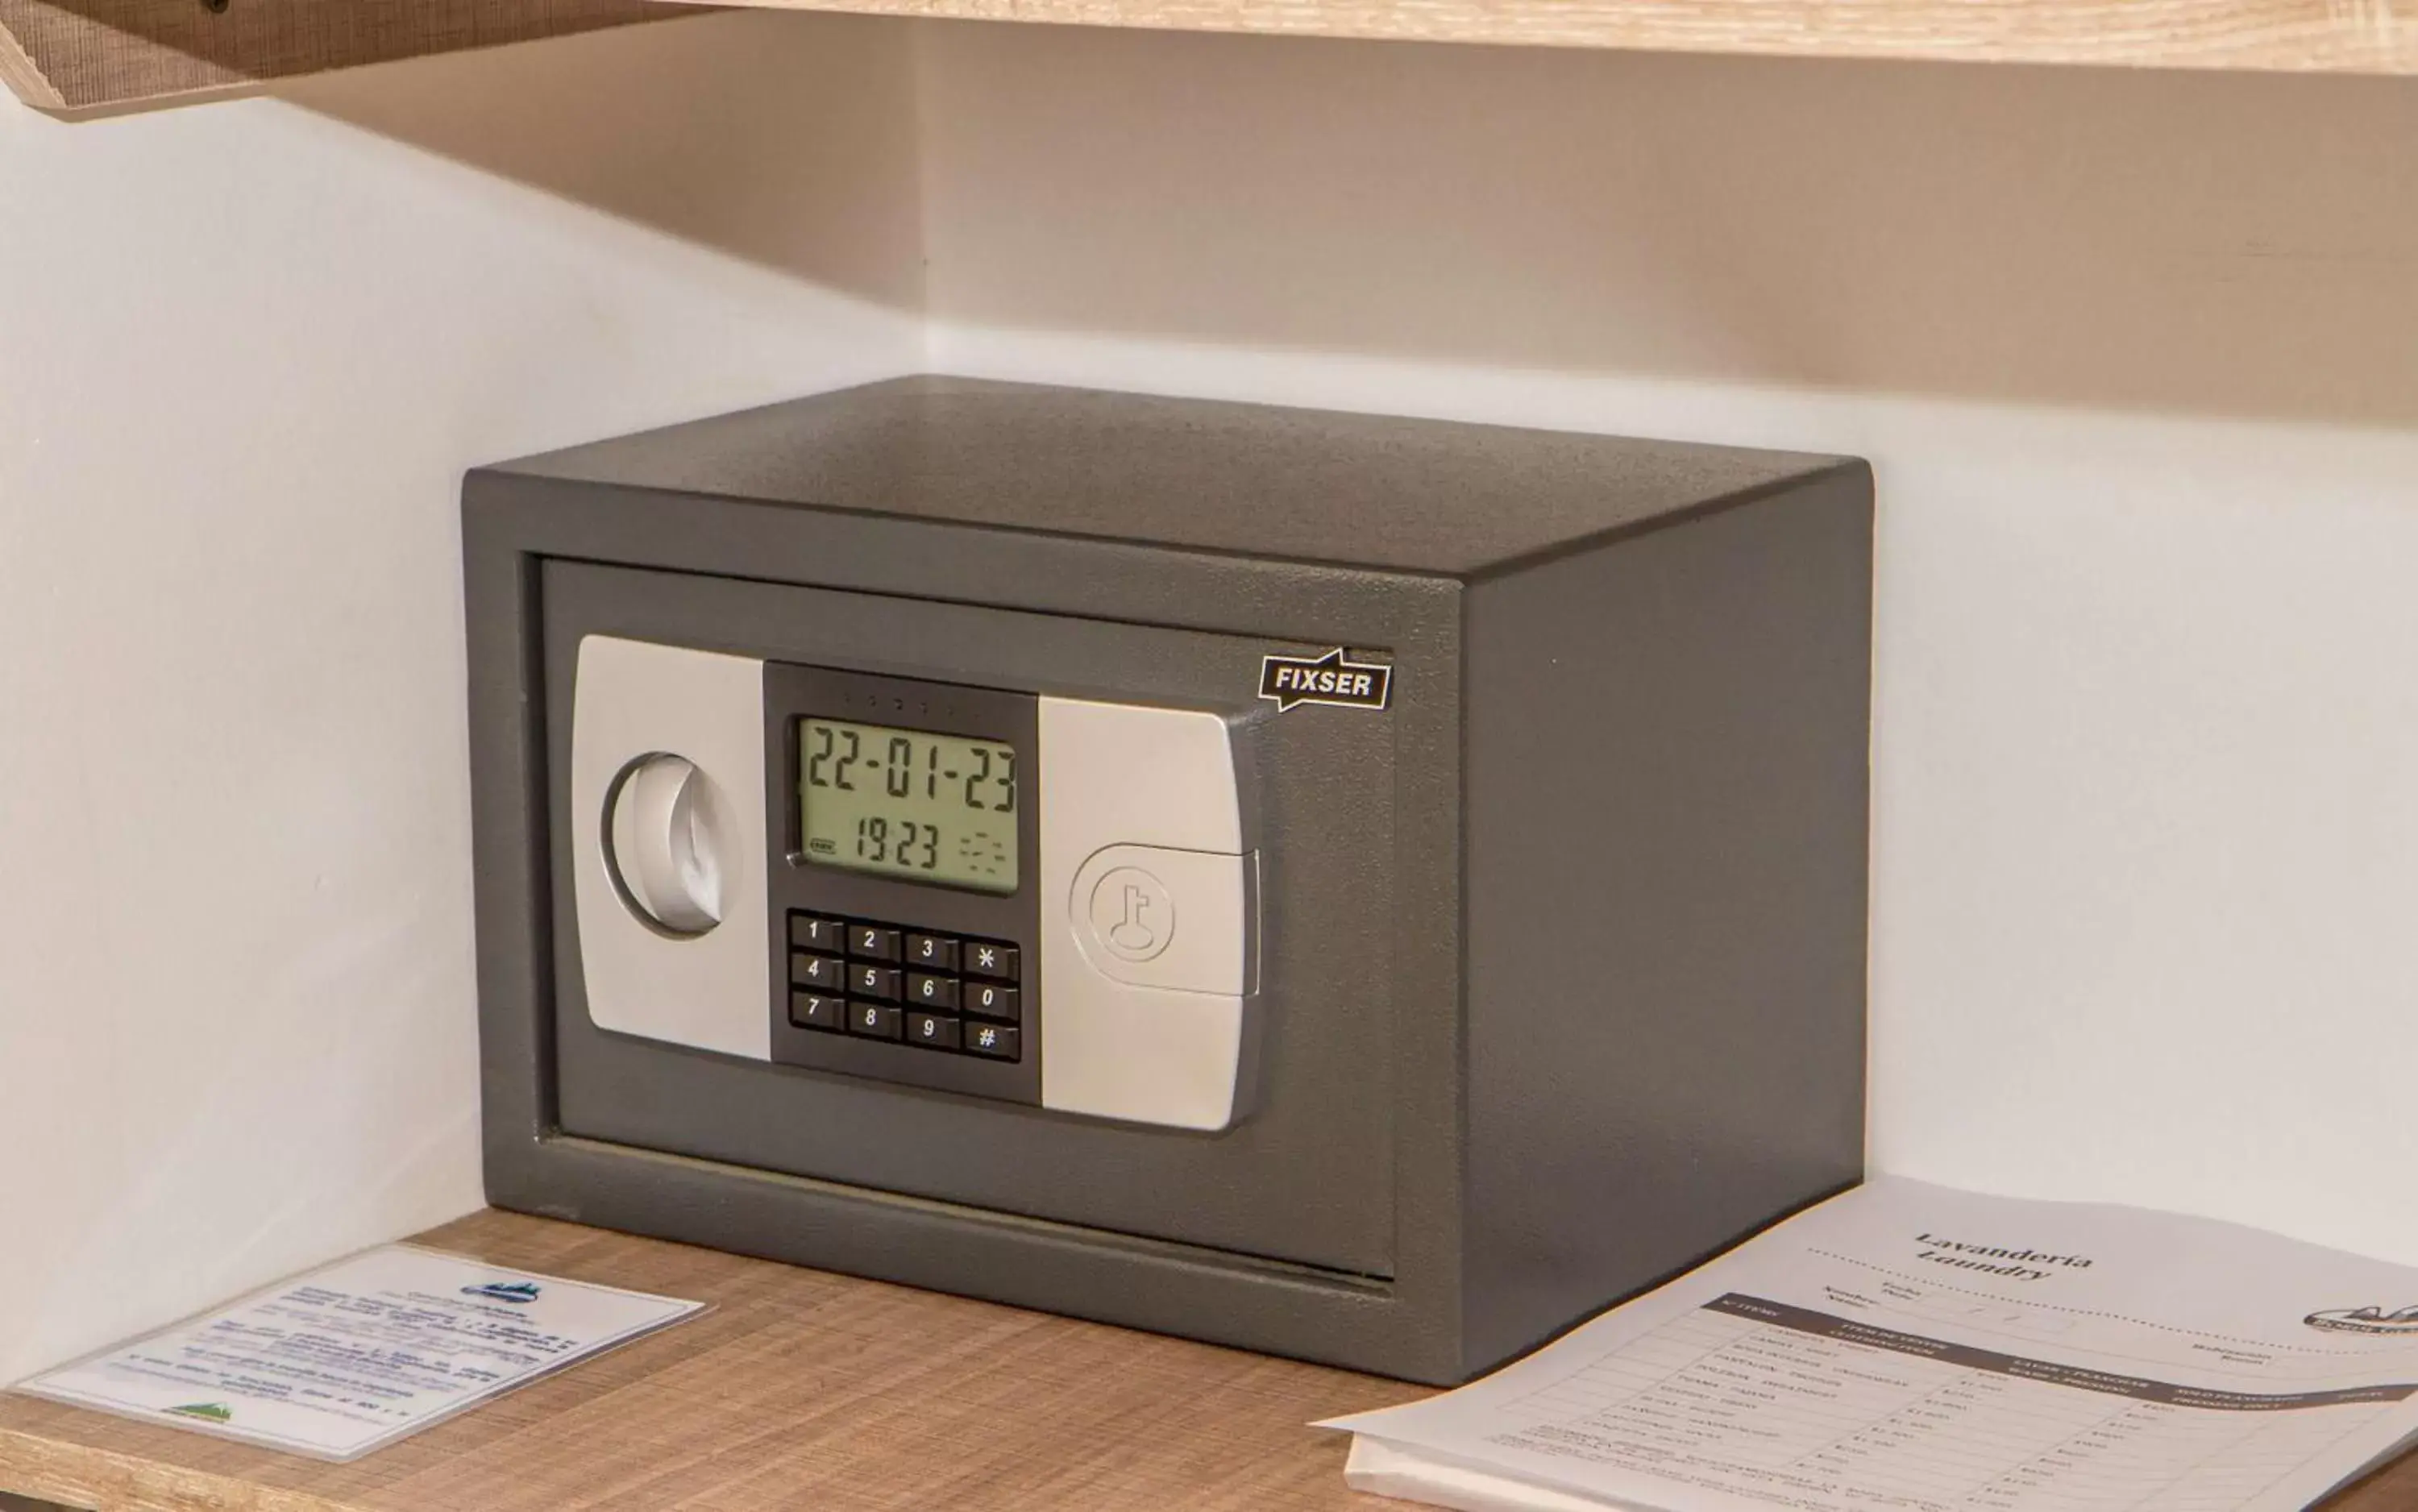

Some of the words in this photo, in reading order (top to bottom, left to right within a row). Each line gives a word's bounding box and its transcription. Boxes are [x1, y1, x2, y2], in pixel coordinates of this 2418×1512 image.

[1276, 667, 1372, 696] FIXSER
[809, 727, 1015, 812] 22-01-23
[809, 921, 818, 938] 1
[864, 931, 875, 948] 2
[922, 940, 933, 957] 3
[808, 960, 819, 977] 4
[865, 970, 876, 986] 5
[923, 980, 934, 996] 6
[808, 999, 819, 1015] 7
[866, 1009, 876, 1025] 8
[924, 1020, 934, 1036] 9
[1917, 1251, 2052, 1281] Laundry
